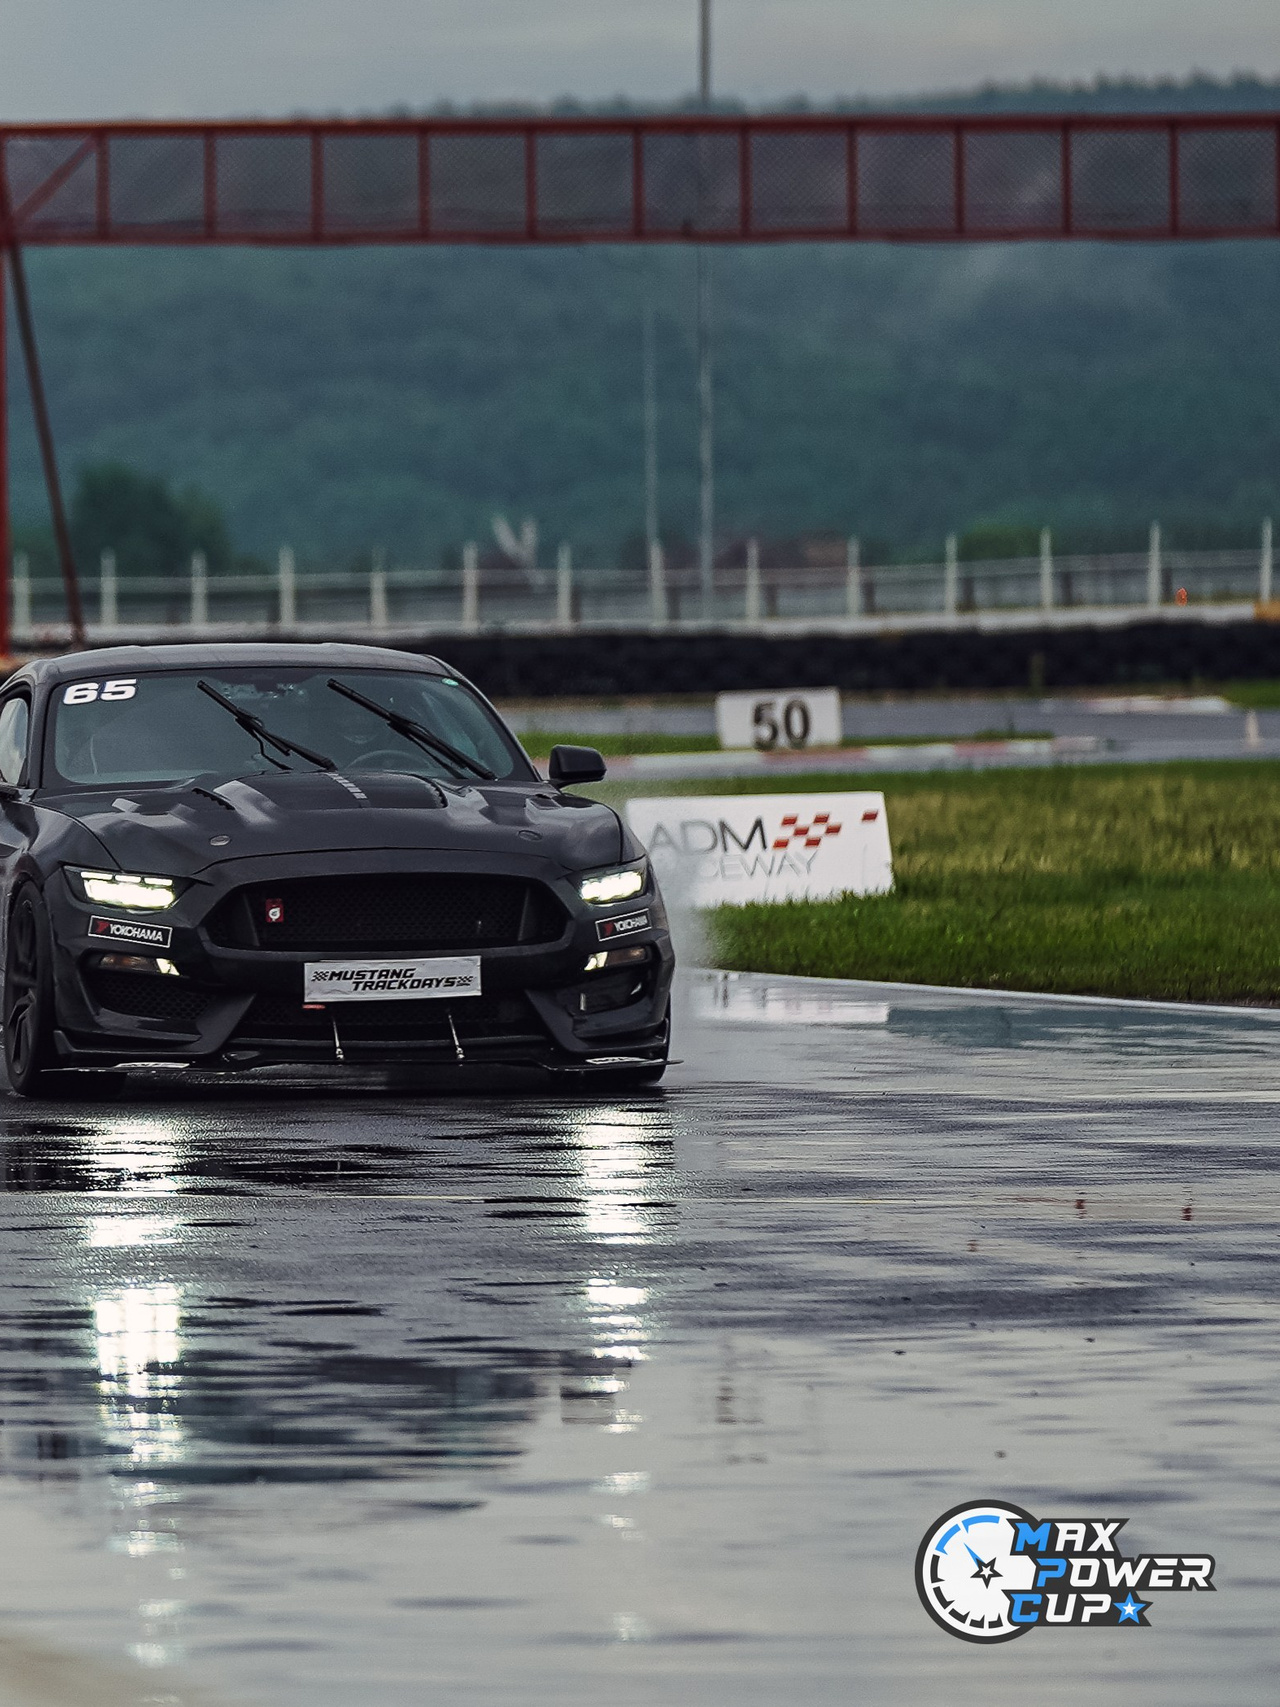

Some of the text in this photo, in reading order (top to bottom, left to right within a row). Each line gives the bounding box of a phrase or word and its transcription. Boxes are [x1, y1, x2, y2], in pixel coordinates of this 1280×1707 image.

[63, 679, 136, 704] 65
[754, 698, 809, 750] 50
[651, 816, 767, 853] ADM
[110, 924, 163, 941] YOKOHAMA
[328, 968, 416, 982] MUSTANG
[352, 976, 457, 991] TRACKDAYS
